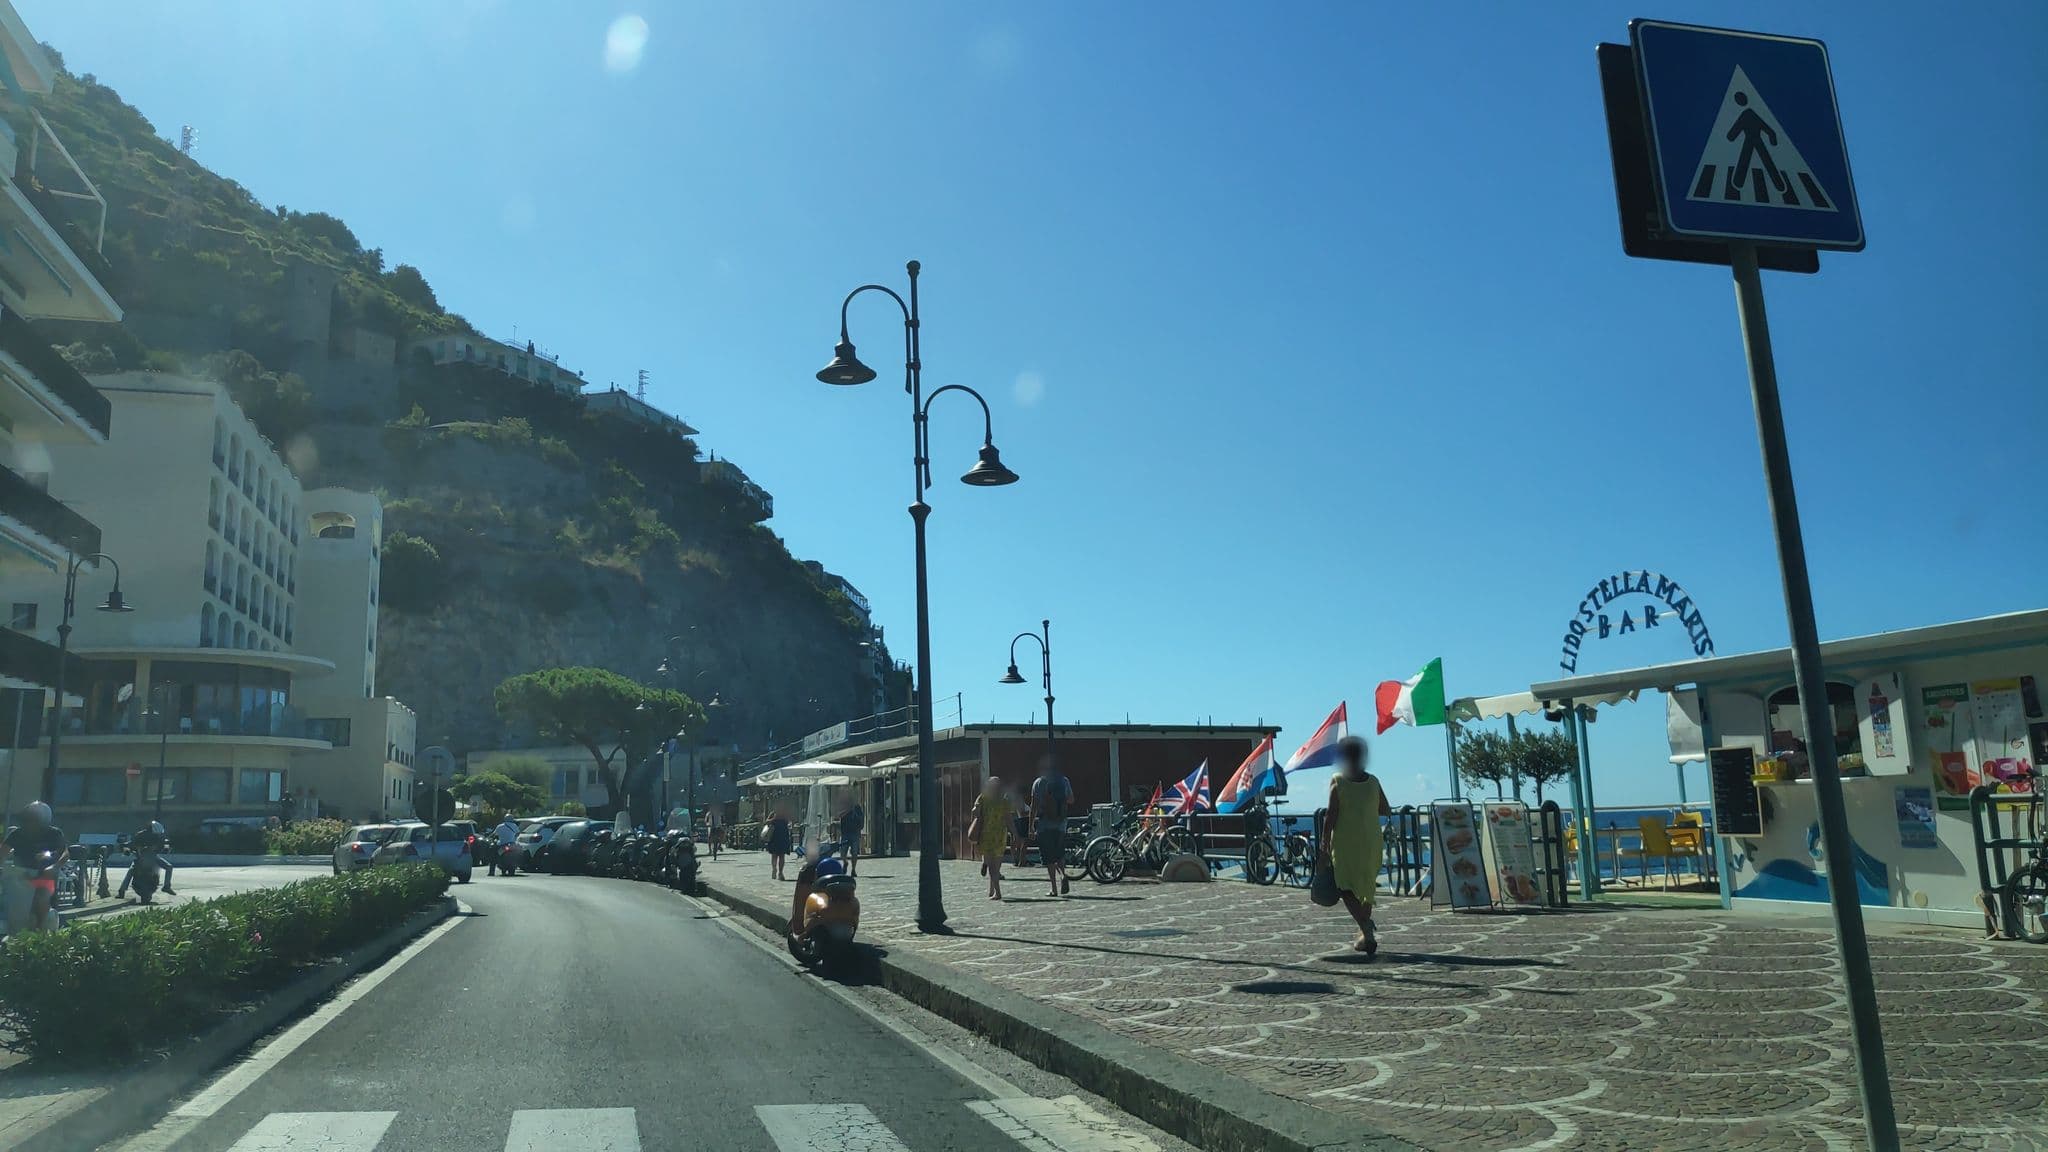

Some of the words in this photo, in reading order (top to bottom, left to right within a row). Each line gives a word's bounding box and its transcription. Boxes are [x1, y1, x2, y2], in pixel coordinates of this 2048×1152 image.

[1560, 619, 1587, 674] LIDO
[1579, 569, 1653, 623] STELLA
[1654, 573, 1714, 656] MARIS
[1598, 605, 1660, 640] BAR
